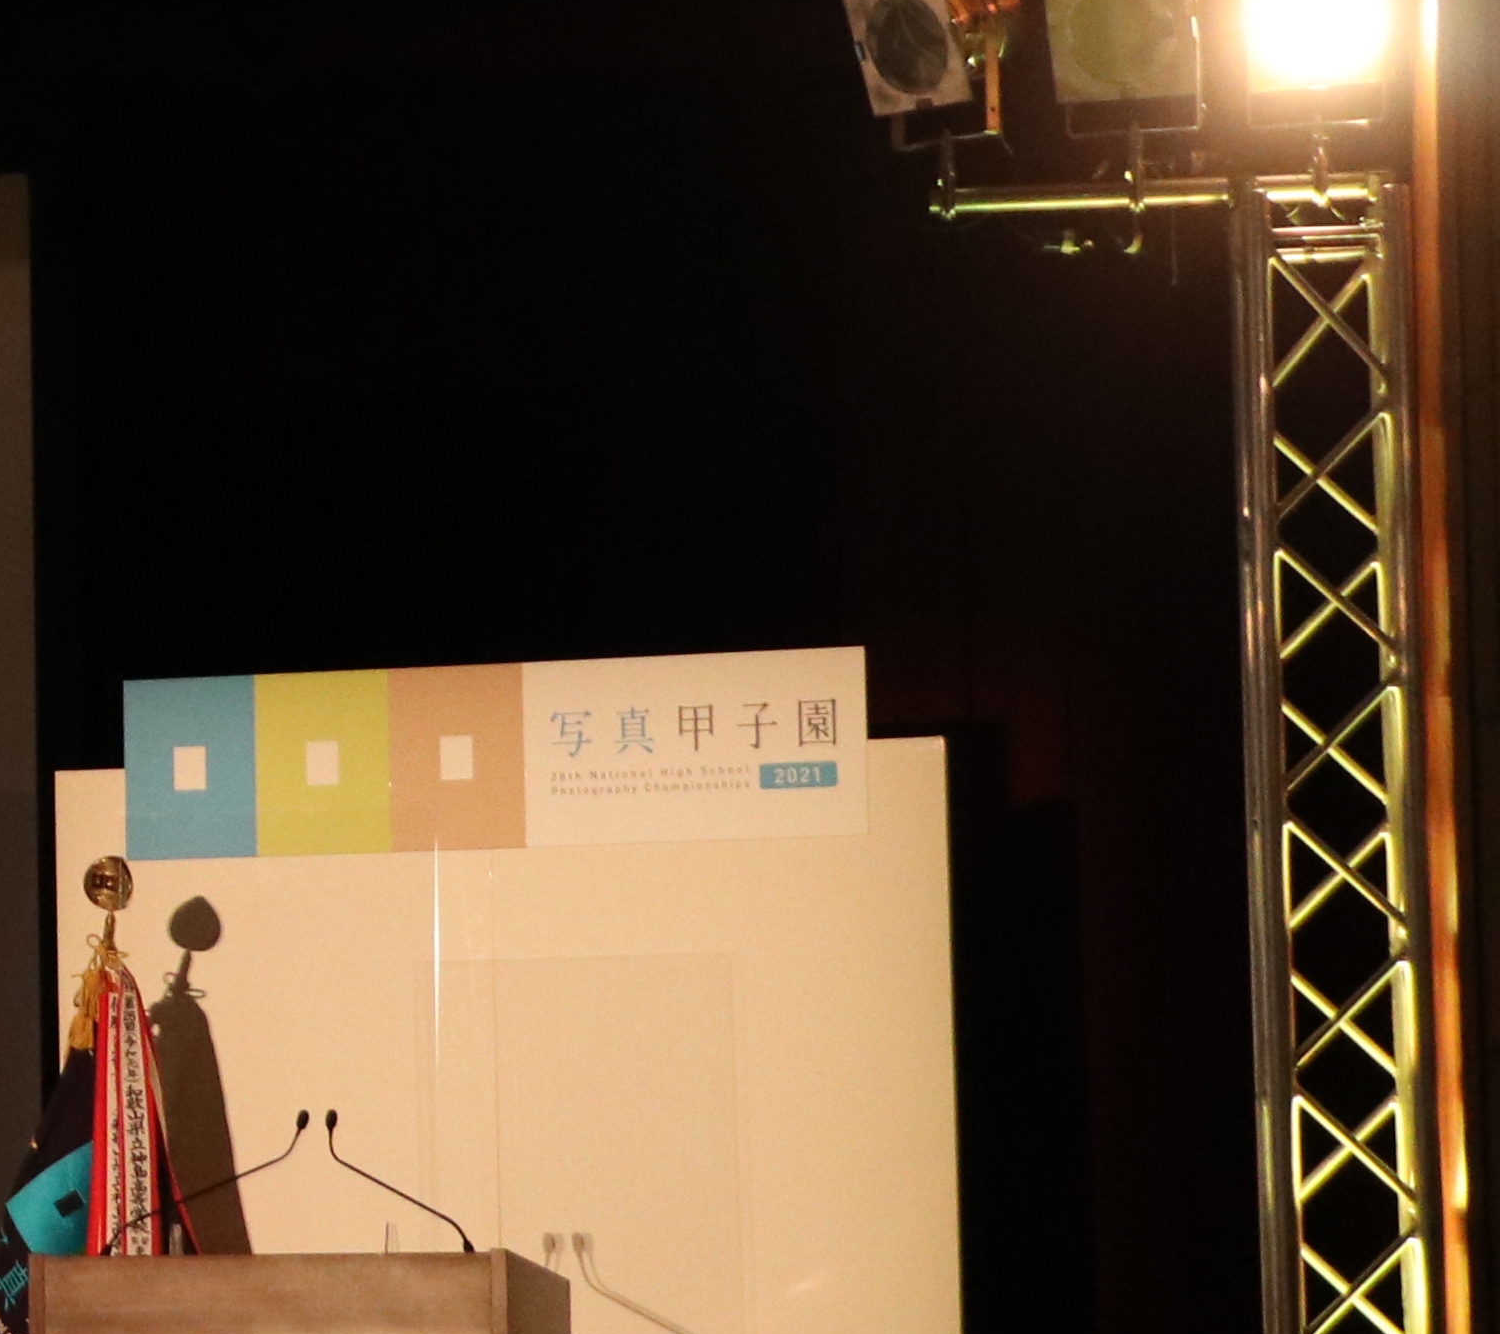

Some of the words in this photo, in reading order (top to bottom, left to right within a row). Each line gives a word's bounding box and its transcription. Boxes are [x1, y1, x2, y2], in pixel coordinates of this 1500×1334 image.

[551, 698, 837, 758] 写真甲子園
[774, 768, 822, 784] 2021
